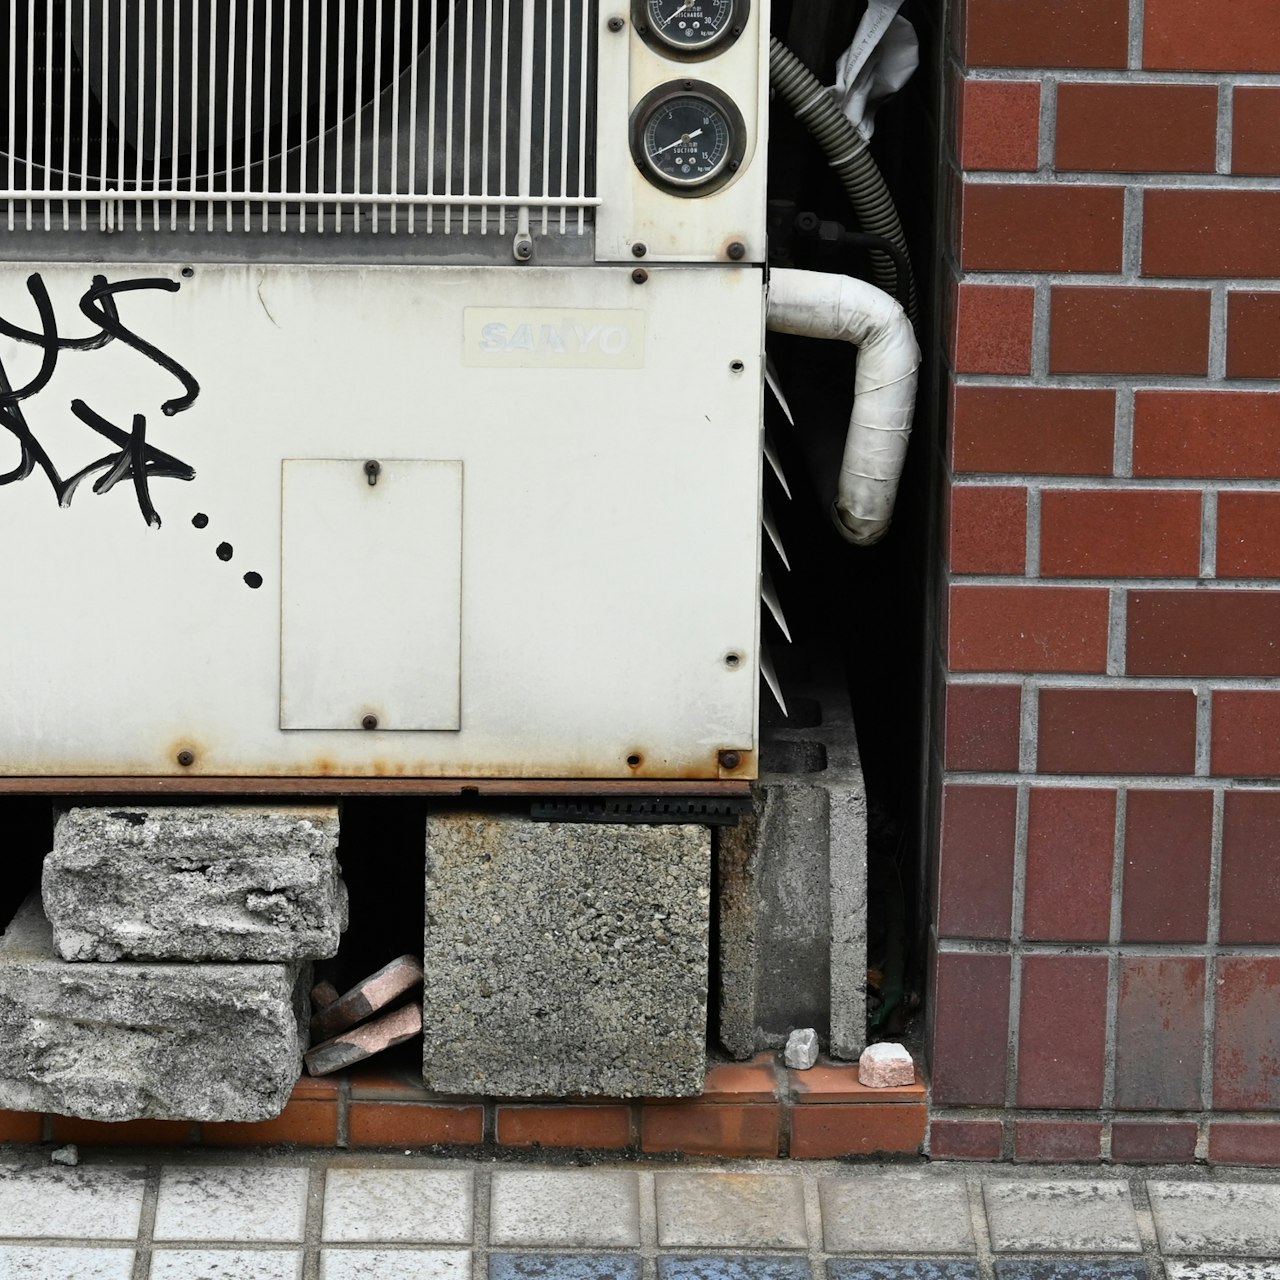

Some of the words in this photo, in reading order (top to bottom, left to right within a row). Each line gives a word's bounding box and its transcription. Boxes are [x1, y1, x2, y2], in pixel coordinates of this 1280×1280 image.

[703, 117, 709, 125] 10
[702, 151, 708, 159] 15
[478, 321, 631, 355] SANYO
